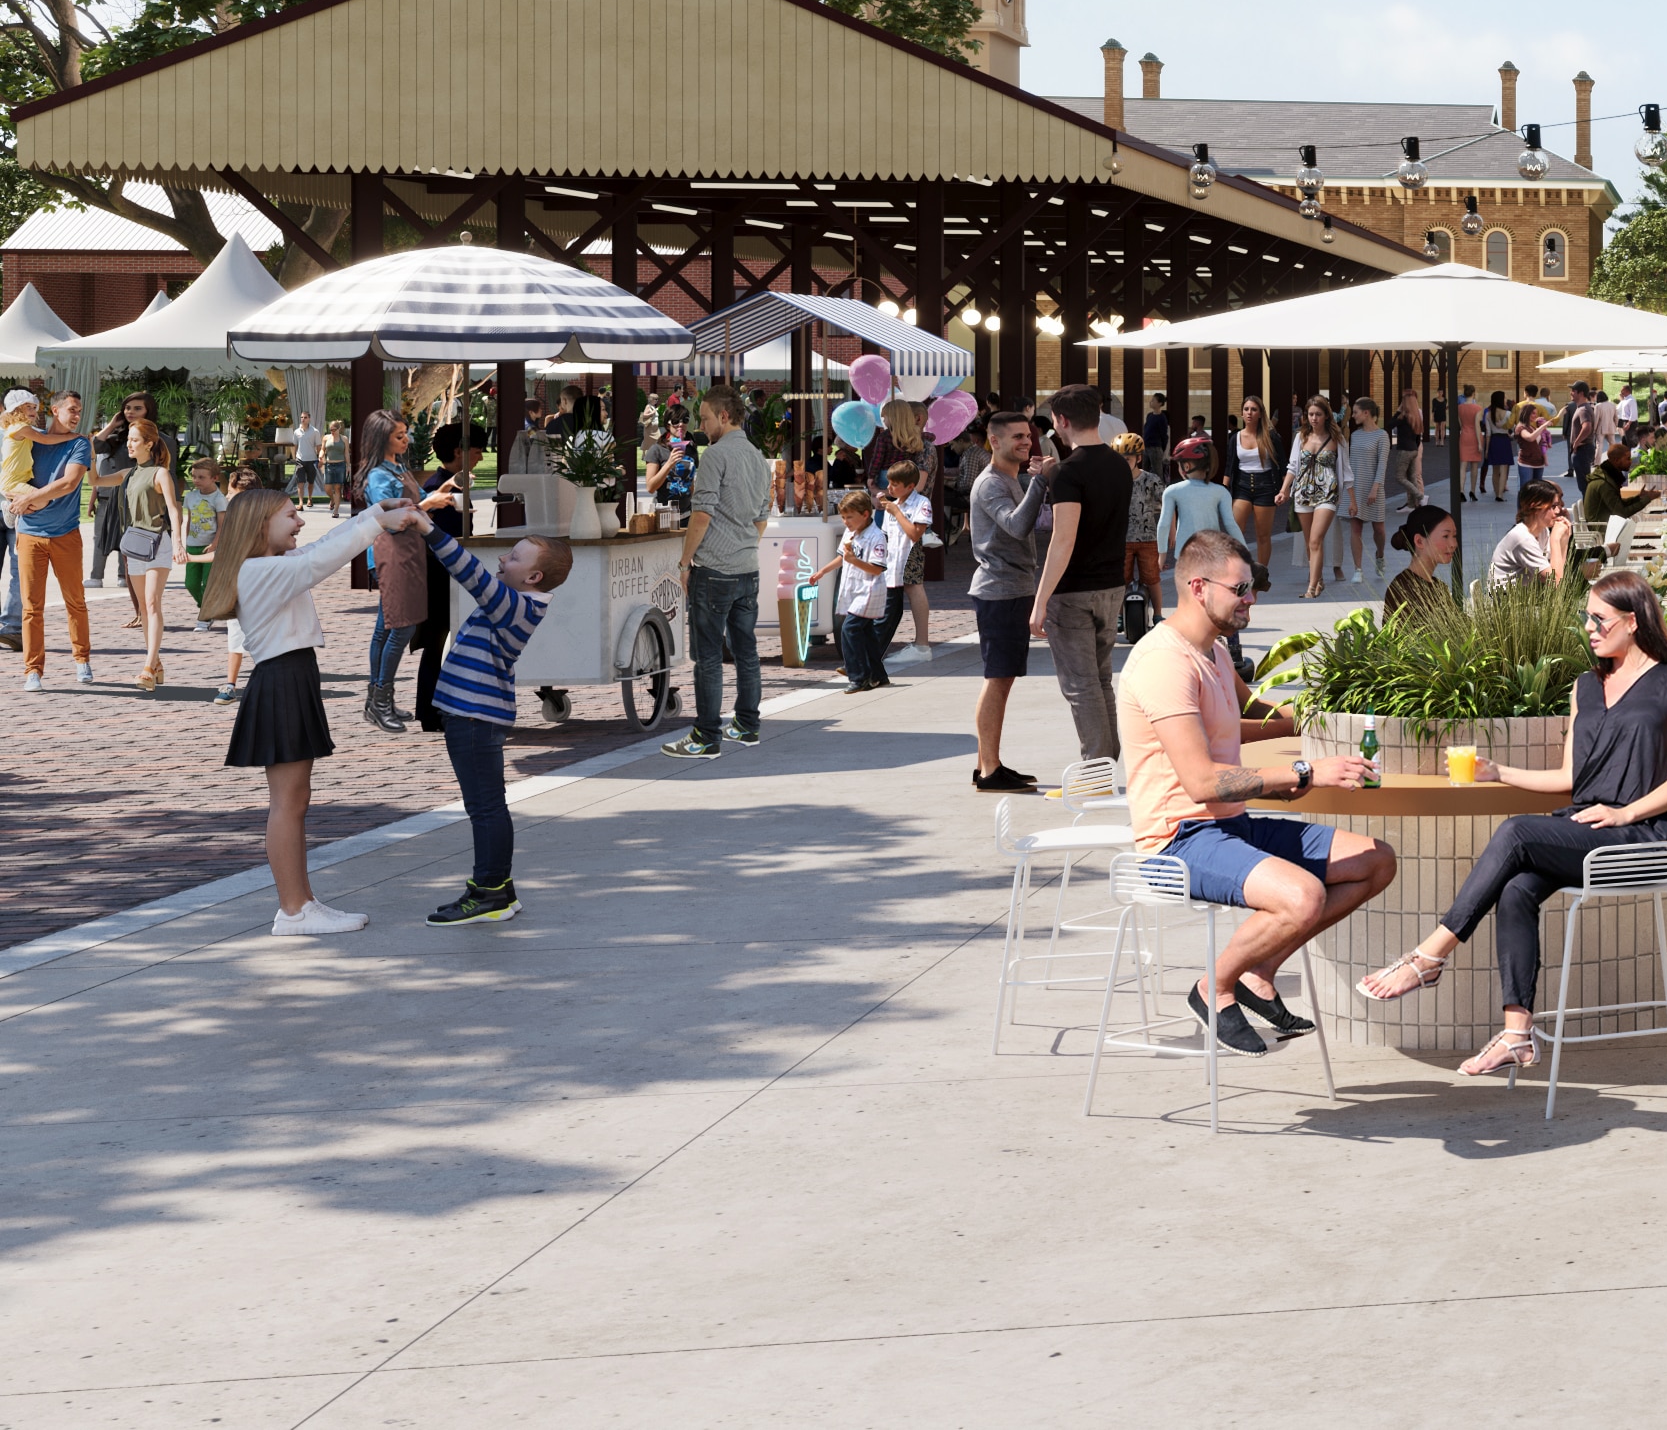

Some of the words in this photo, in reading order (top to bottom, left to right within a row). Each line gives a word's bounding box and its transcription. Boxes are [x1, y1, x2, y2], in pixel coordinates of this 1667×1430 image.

[611, 556, 644, 578] URBAN
[611, 575, 649, 599] COFFEE
[651, 578, 682, 610] ESPRESSO
